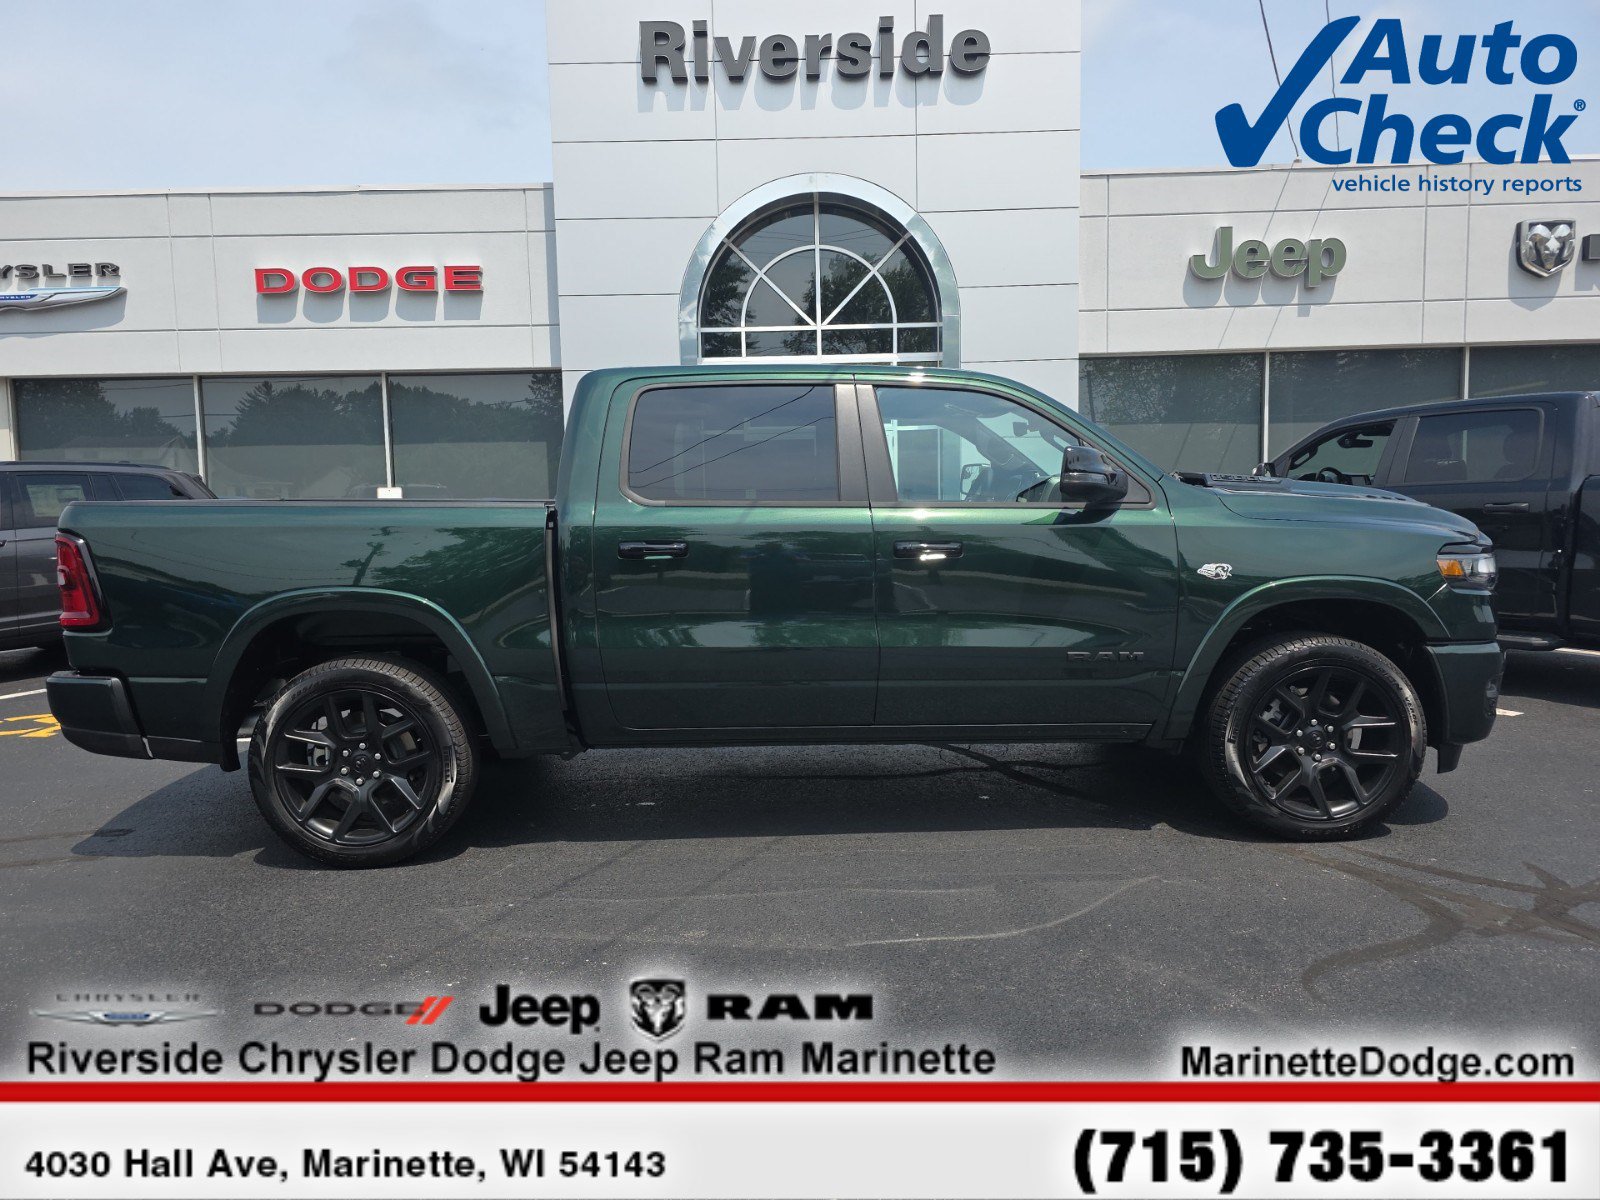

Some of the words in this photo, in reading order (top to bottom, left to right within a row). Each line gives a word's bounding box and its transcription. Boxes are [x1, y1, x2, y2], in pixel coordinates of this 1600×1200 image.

[639, 14, 991, 83] Riverside
[254, 265, 483, 294] DODGE
[1189, 226, 1347, 288] Jeep
[1066, 651, 1144, 663] RAM
